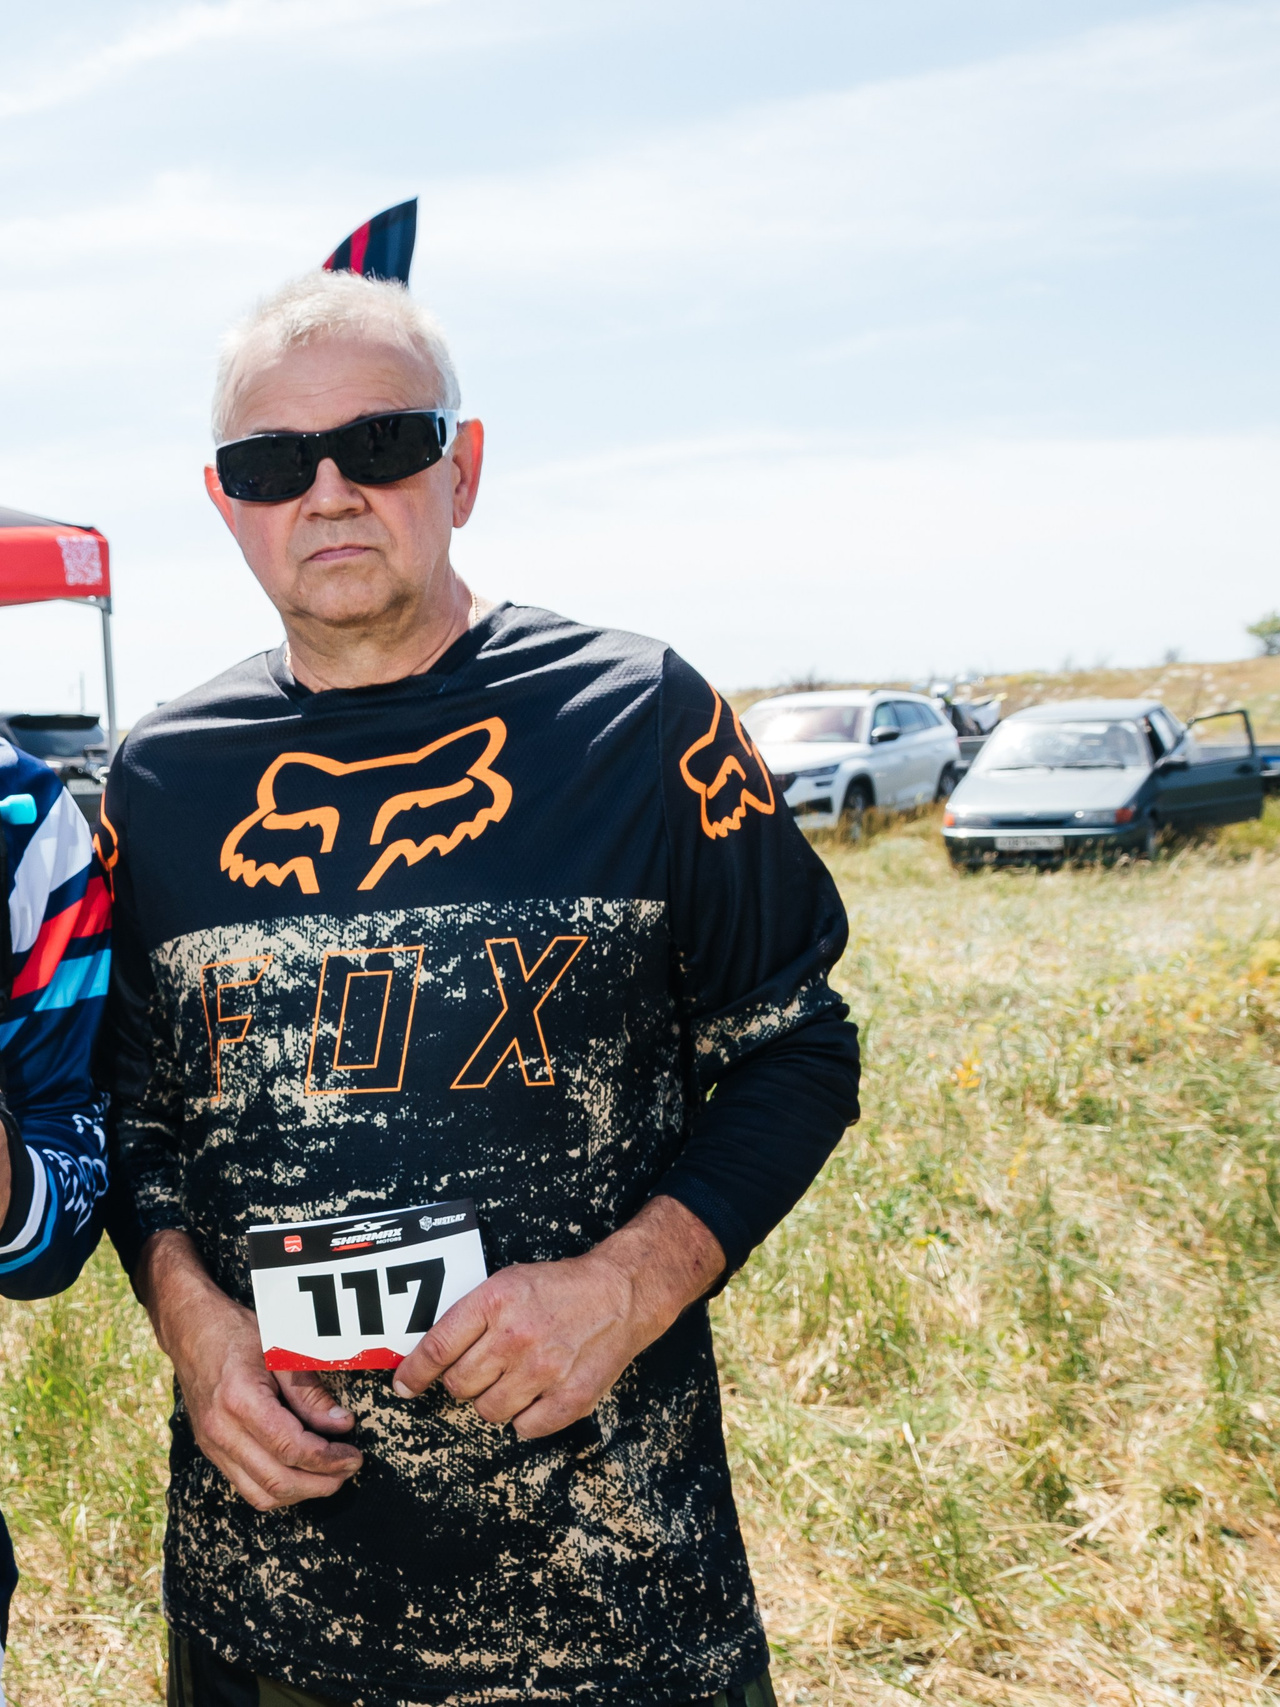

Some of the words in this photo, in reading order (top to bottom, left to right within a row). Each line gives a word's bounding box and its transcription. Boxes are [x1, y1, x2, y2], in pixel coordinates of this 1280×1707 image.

[200, 936, 588, 1101] FOX
[329, 1227, 403, 1247] SHARMAX
[375, 1236, 402, 1245] MOTORS
[297, 1257, 446, 1337] 117
